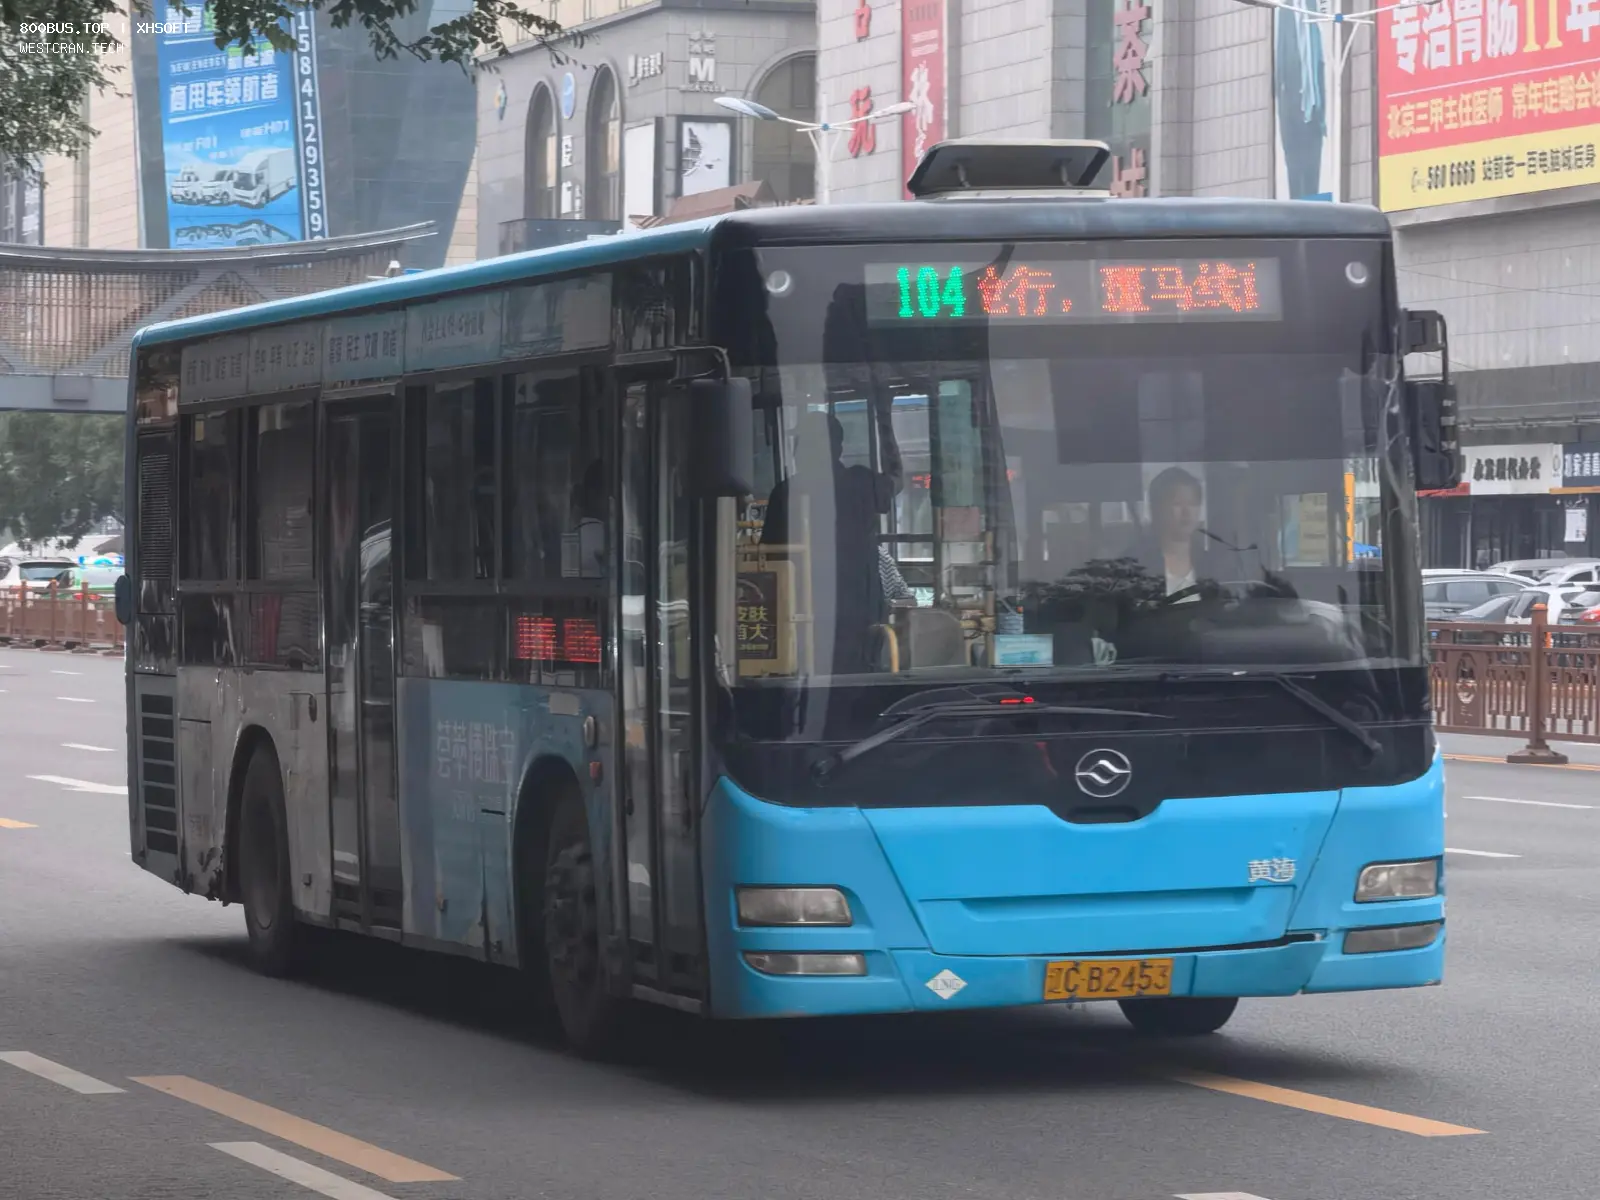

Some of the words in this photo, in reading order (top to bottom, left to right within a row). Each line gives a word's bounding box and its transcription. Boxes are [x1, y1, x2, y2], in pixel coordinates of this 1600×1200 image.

[297, 11, 325, 240] 1584129359
[897, 265, 966, 318] 104
[1247, 858, 1299, 883] 黄海
